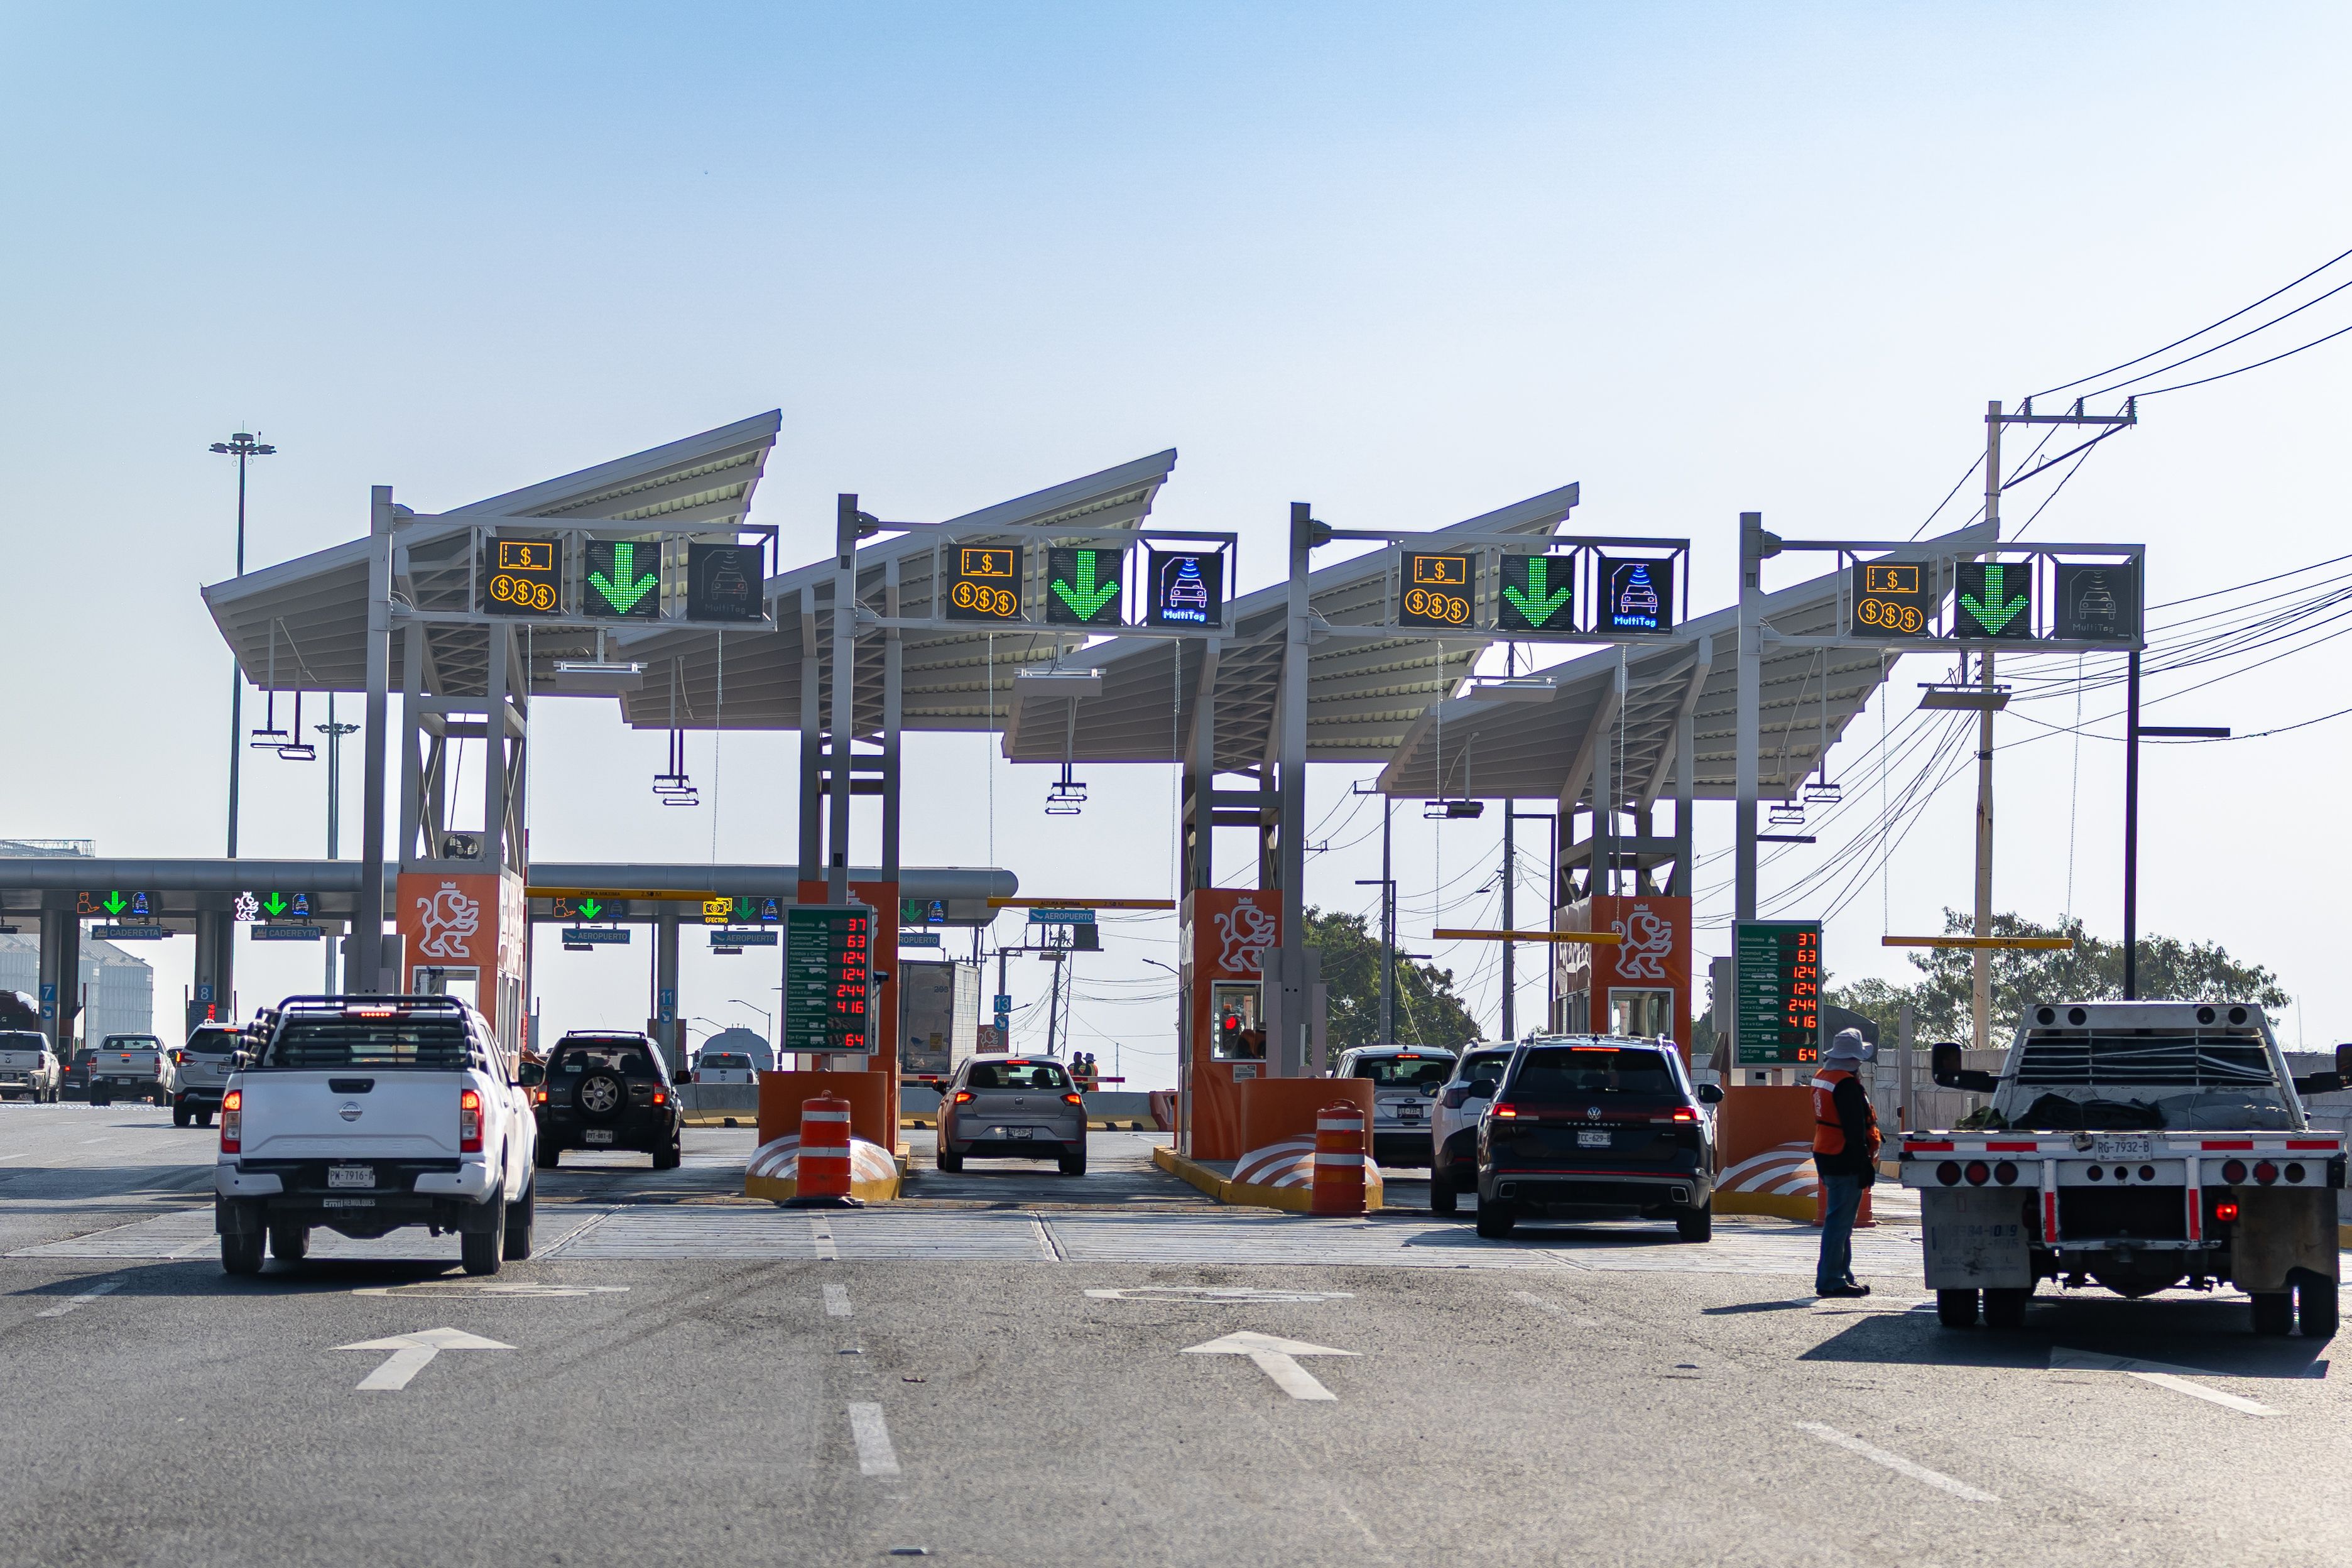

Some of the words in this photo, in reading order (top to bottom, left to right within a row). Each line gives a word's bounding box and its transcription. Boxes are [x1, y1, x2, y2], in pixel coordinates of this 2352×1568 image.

[705, 603, 746, 614] MultiTag
[1163, 610, 1206, 622] MultiTag
[1614, 616, 1656, 627] MultiTag
[2072, 623, 2115, 633] MultiTag
[848, 918, 866, 931] 37
[847, 935, 866, 948] 63
[1799, 934, 1816, 946] 37
[842, 951, 865, 964] 124
[1797, 950, 1816, 962] 63
[842, 967, 865, 981] 124
[1794, 967, 1816, 978] 124
[43, 986, 52, 999] 7
[200, 988, 209, 1000] 8
[837, 984, 865, 997] 244
[1794, 983, 1816, 995] 124
[660, 991, 672, 1004] 11
[996, 998, 1009, 1010] 13
[1788, 999, 1816, 1011] 244
[845, 1033, 864, 1047] 64
[1799, 1049, 1817, 1061] 64
[2098, 1141, 2150, 1153] RG-7932-B
[330, 1171, 373, 1180] PW-7916-A
[324, 1199, 343, 1207] Emil
